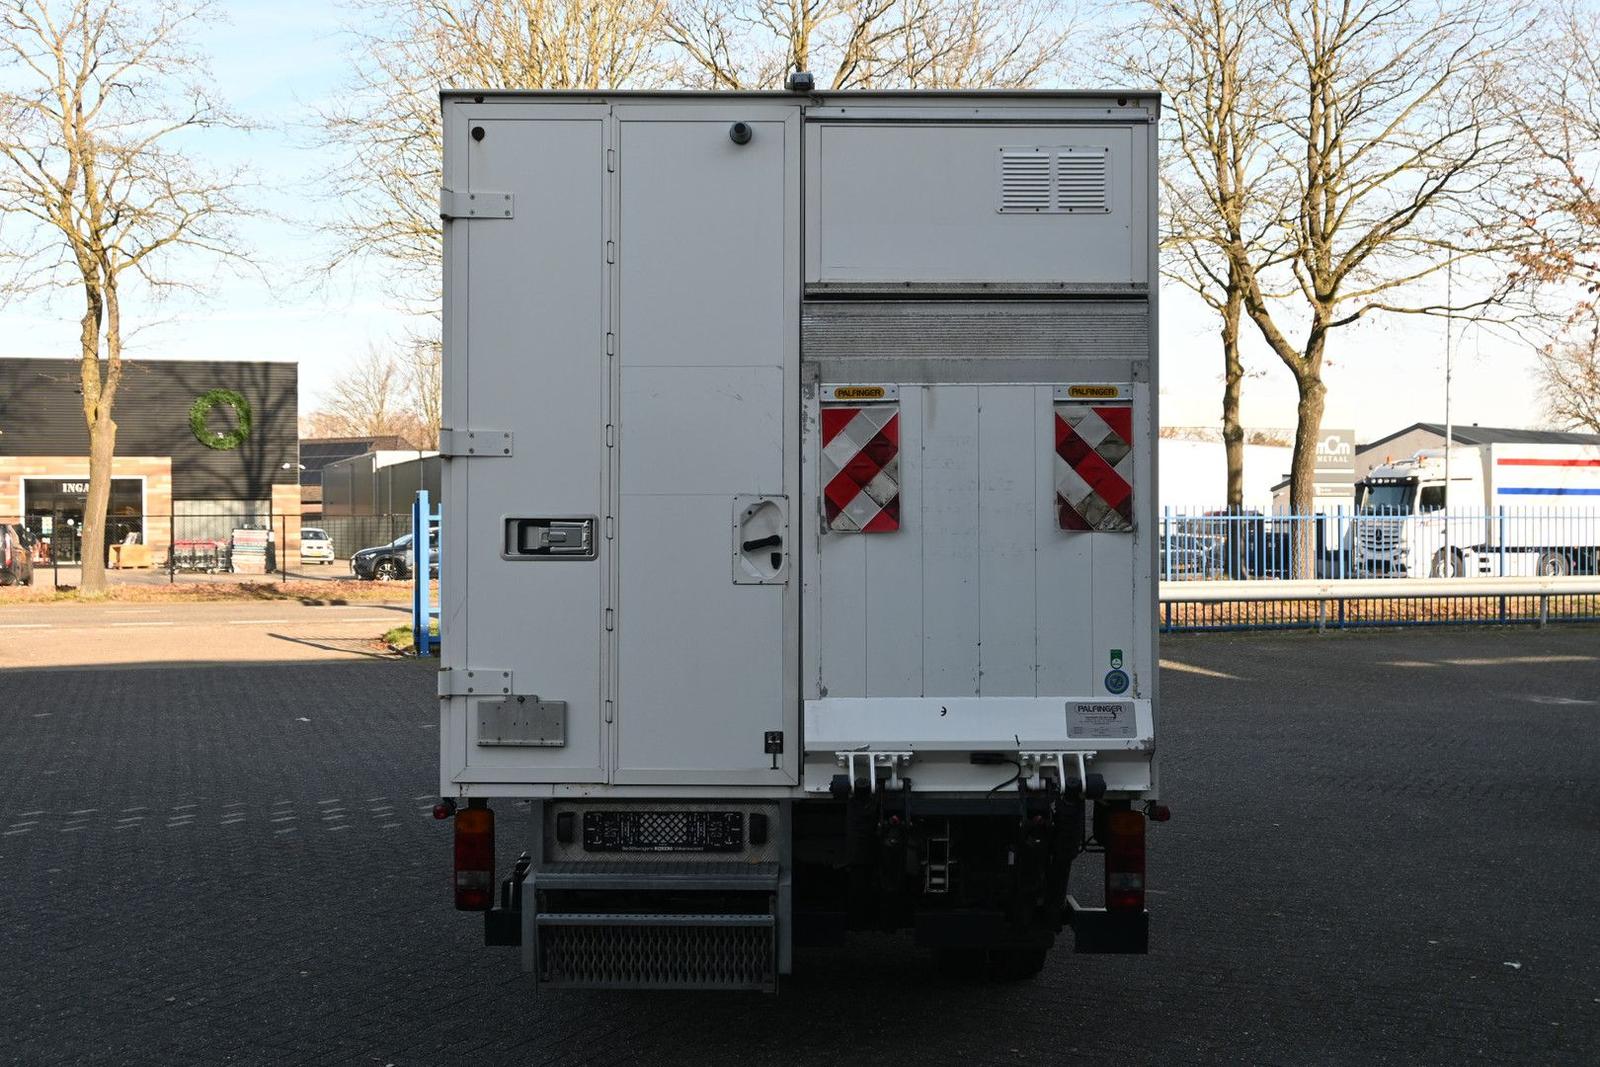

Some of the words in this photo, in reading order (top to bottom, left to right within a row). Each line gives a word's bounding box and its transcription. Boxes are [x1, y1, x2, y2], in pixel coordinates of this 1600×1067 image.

[838, 388, 881, 397] PALFINGER
[1071, 387, 1115, 396] PALFINGER
[1316, 455, 1348, 463] METAAL
[1077, 705, 1123, 713] PALFINGER
